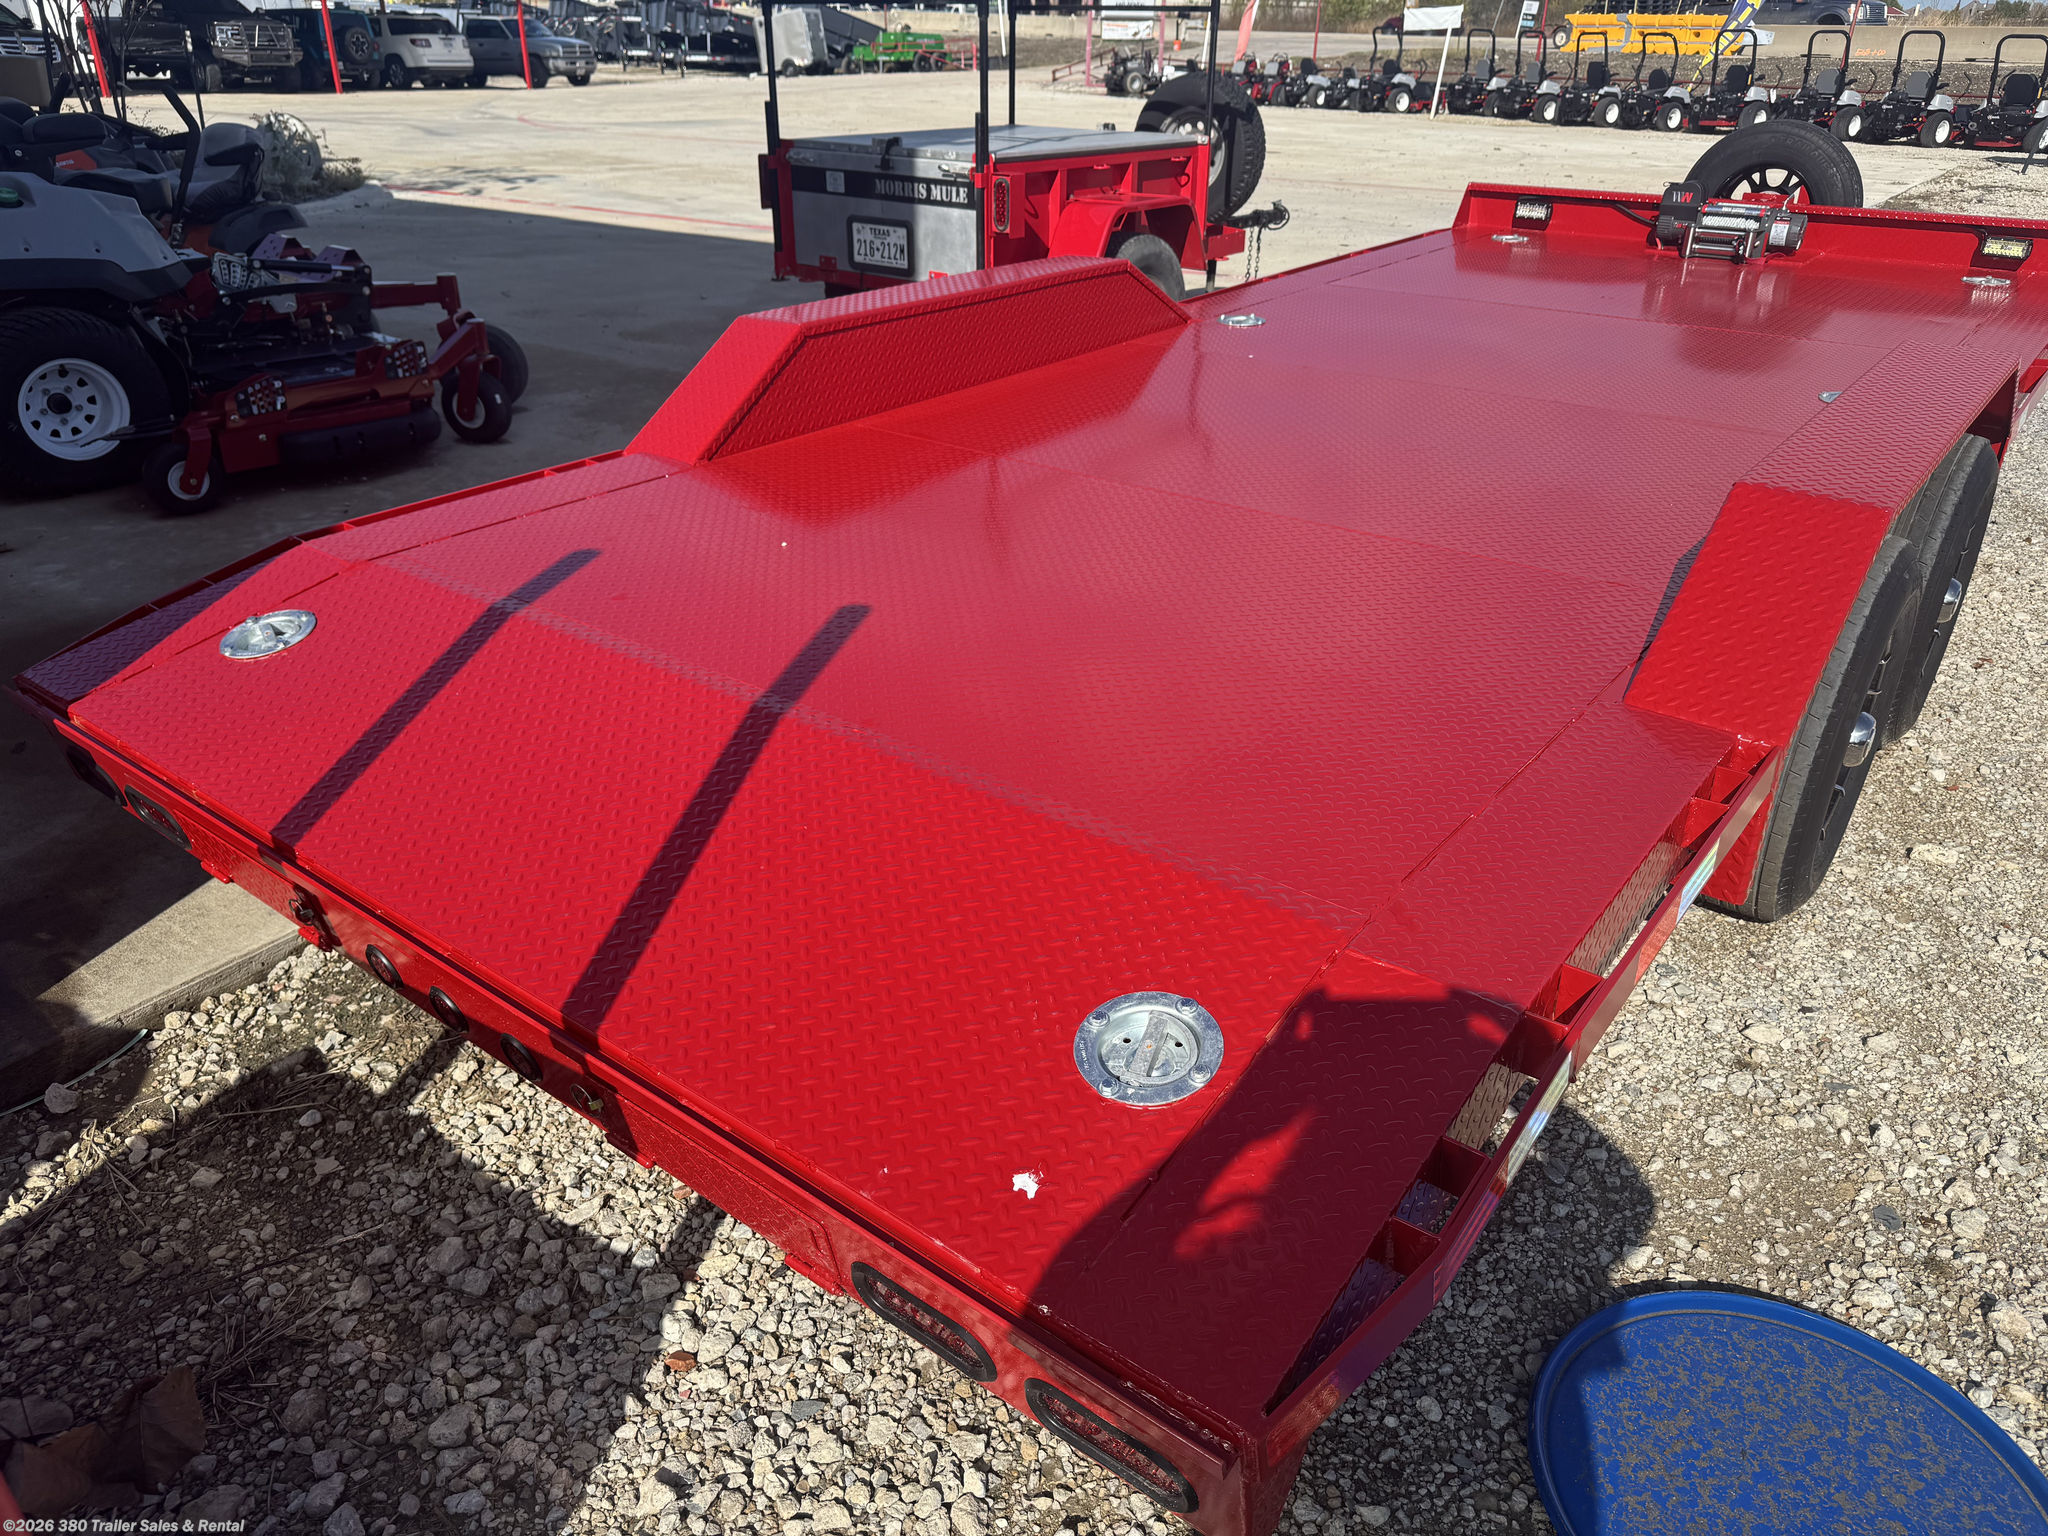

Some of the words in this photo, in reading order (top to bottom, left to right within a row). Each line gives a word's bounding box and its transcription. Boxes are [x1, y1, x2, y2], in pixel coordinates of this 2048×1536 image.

[875, 179, 927, 199] MORRIS
[930, 184, 968, 204] MULE
[869, 227, 890, 237] TEXAS
